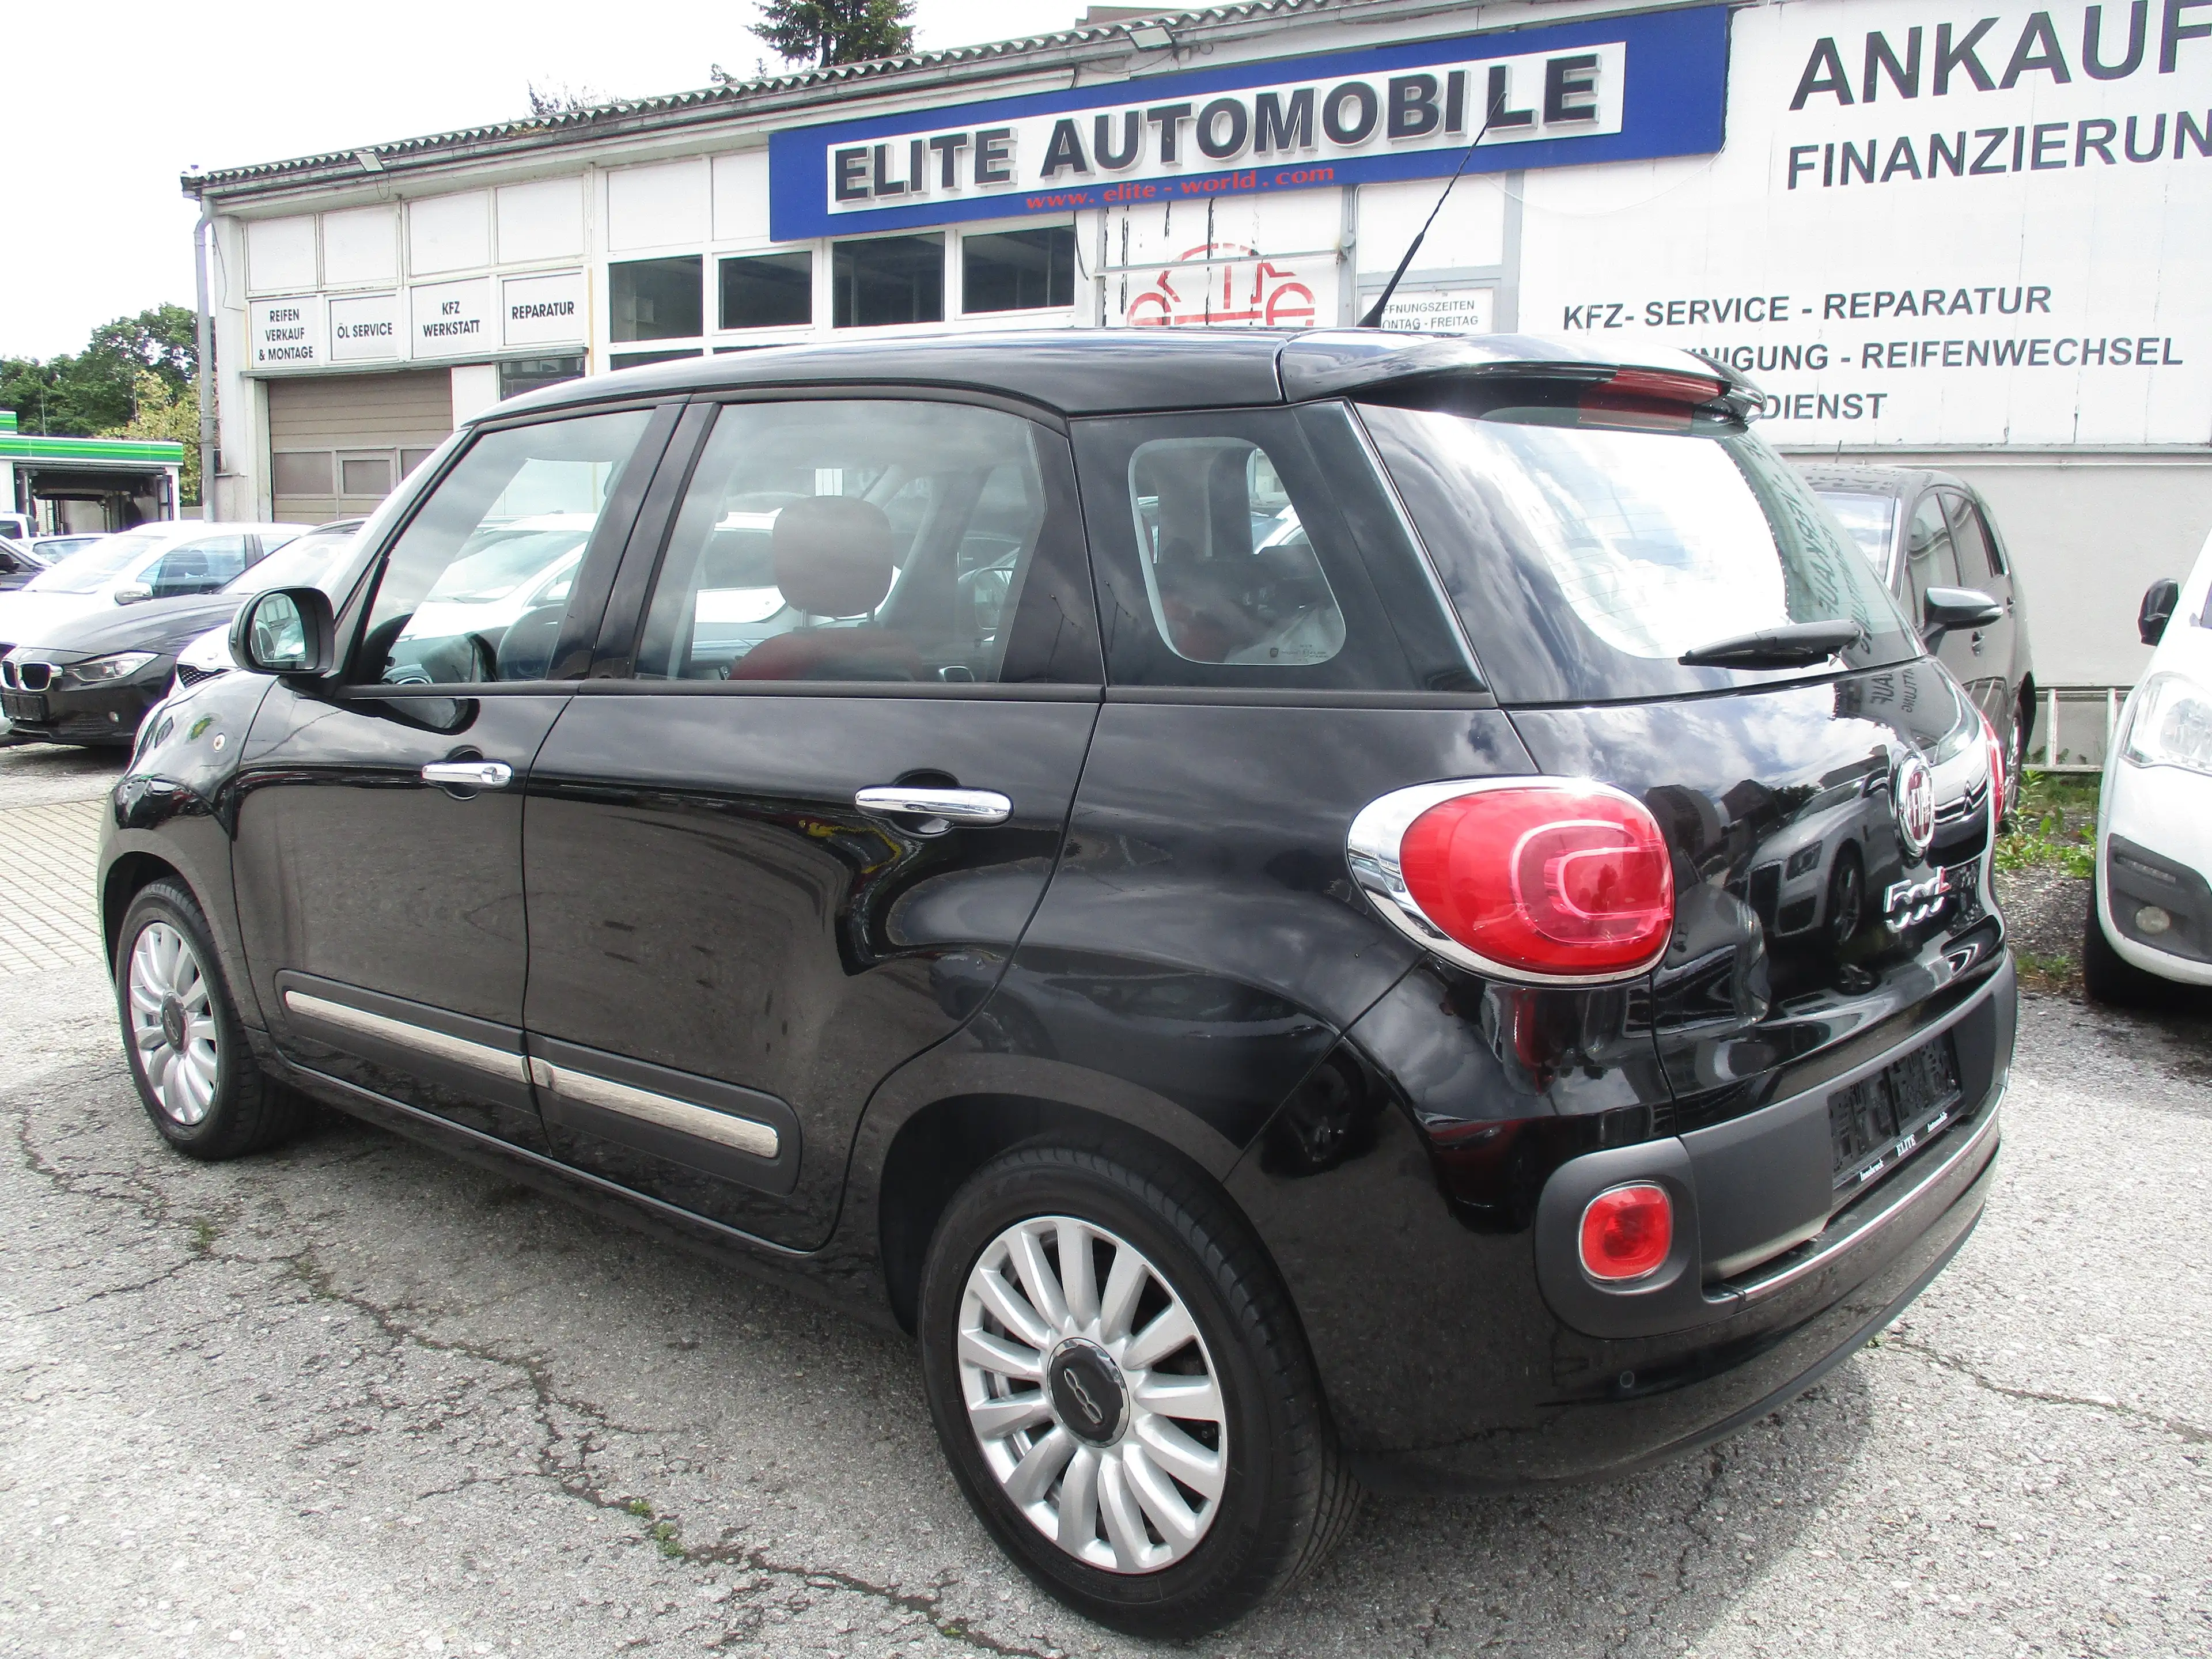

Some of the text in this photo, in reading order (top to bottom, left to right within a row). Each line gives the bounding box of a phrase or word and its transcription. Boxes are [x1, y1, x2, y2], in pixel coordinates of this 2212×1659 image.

[1788, 0, 2212, 110] ANKAUF
[835, 53, 1601, 203] ELITE AUTOMOBILE
[442, 301, 460, 316] KFZ
[512, 301, 575, 320] REPARATUR
[1383, 300, 1475, 314] FFNUNGSZEITEN
[1644, 296, 1790, 326] SERVICE
[1824, 286, 2051, 320] REPARATUR
[270, 309, 300, 323] REIFEN
[1382, 318, 1421, 331] ONTAG
[1431, 316, 1479, 329] FREITAG
[265, 327, 305, 342] VERKAUF
[337, 323, 393, 339] ÖL SERVICE
[423, 319, 480, 338] WERKSTATT
[259, 346, 313, 361] & MONTAGE
[1861, 337, 2184, 369] REIFENWECHSEL
[1896, 1134, 1916, 1157] ELITE
